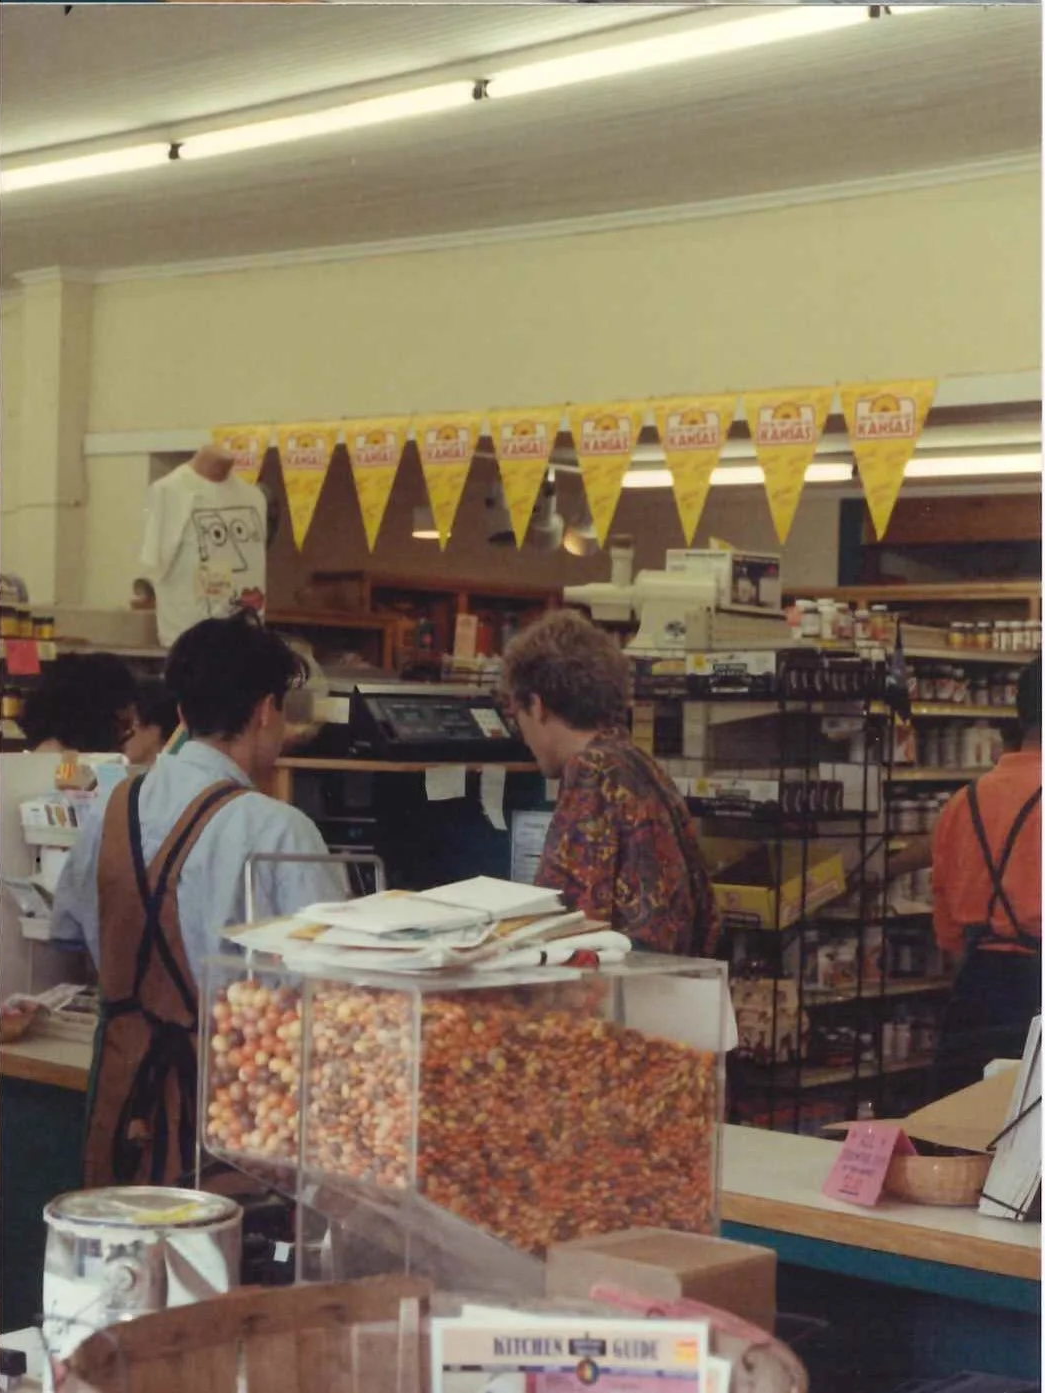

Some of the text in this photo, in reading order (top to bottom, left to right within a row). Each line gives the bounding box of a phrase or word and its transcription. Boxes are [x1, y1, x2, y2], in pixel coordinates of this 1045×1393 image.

[760, 425, 810, 442] KANSAS
[858, 417, 913, 436] KANSAS
[583, 436, 630, 451] KANSAS
[668, 433, 717, 447] KANSAS
[492, 1336, 660, 1360] KITCHEN GUIDE
